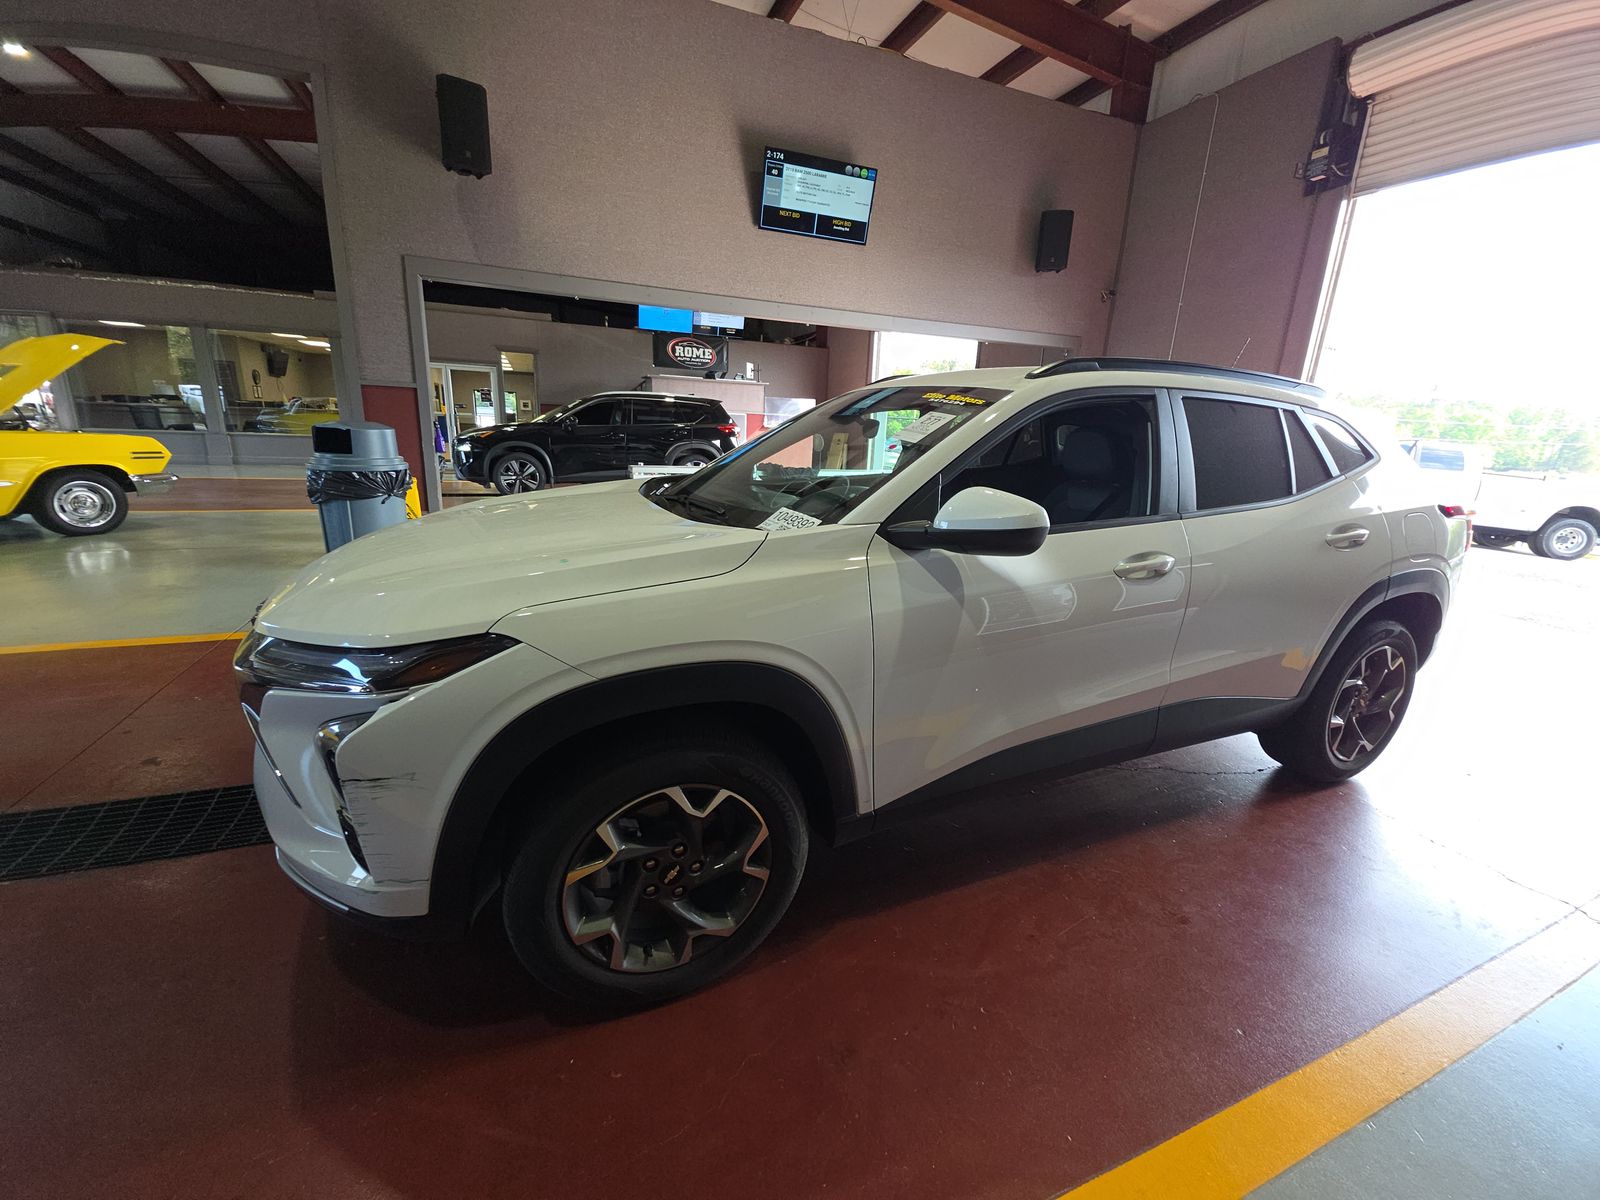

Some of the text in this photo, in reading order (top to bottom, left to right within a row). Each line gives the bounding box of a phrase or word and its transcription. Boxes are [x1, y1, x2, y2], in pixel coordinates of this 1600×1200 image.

[766, 150, 784, 160] 2-174
[675, 345, 712, 359] ROME
[946, 394, 986, 404] Motors
